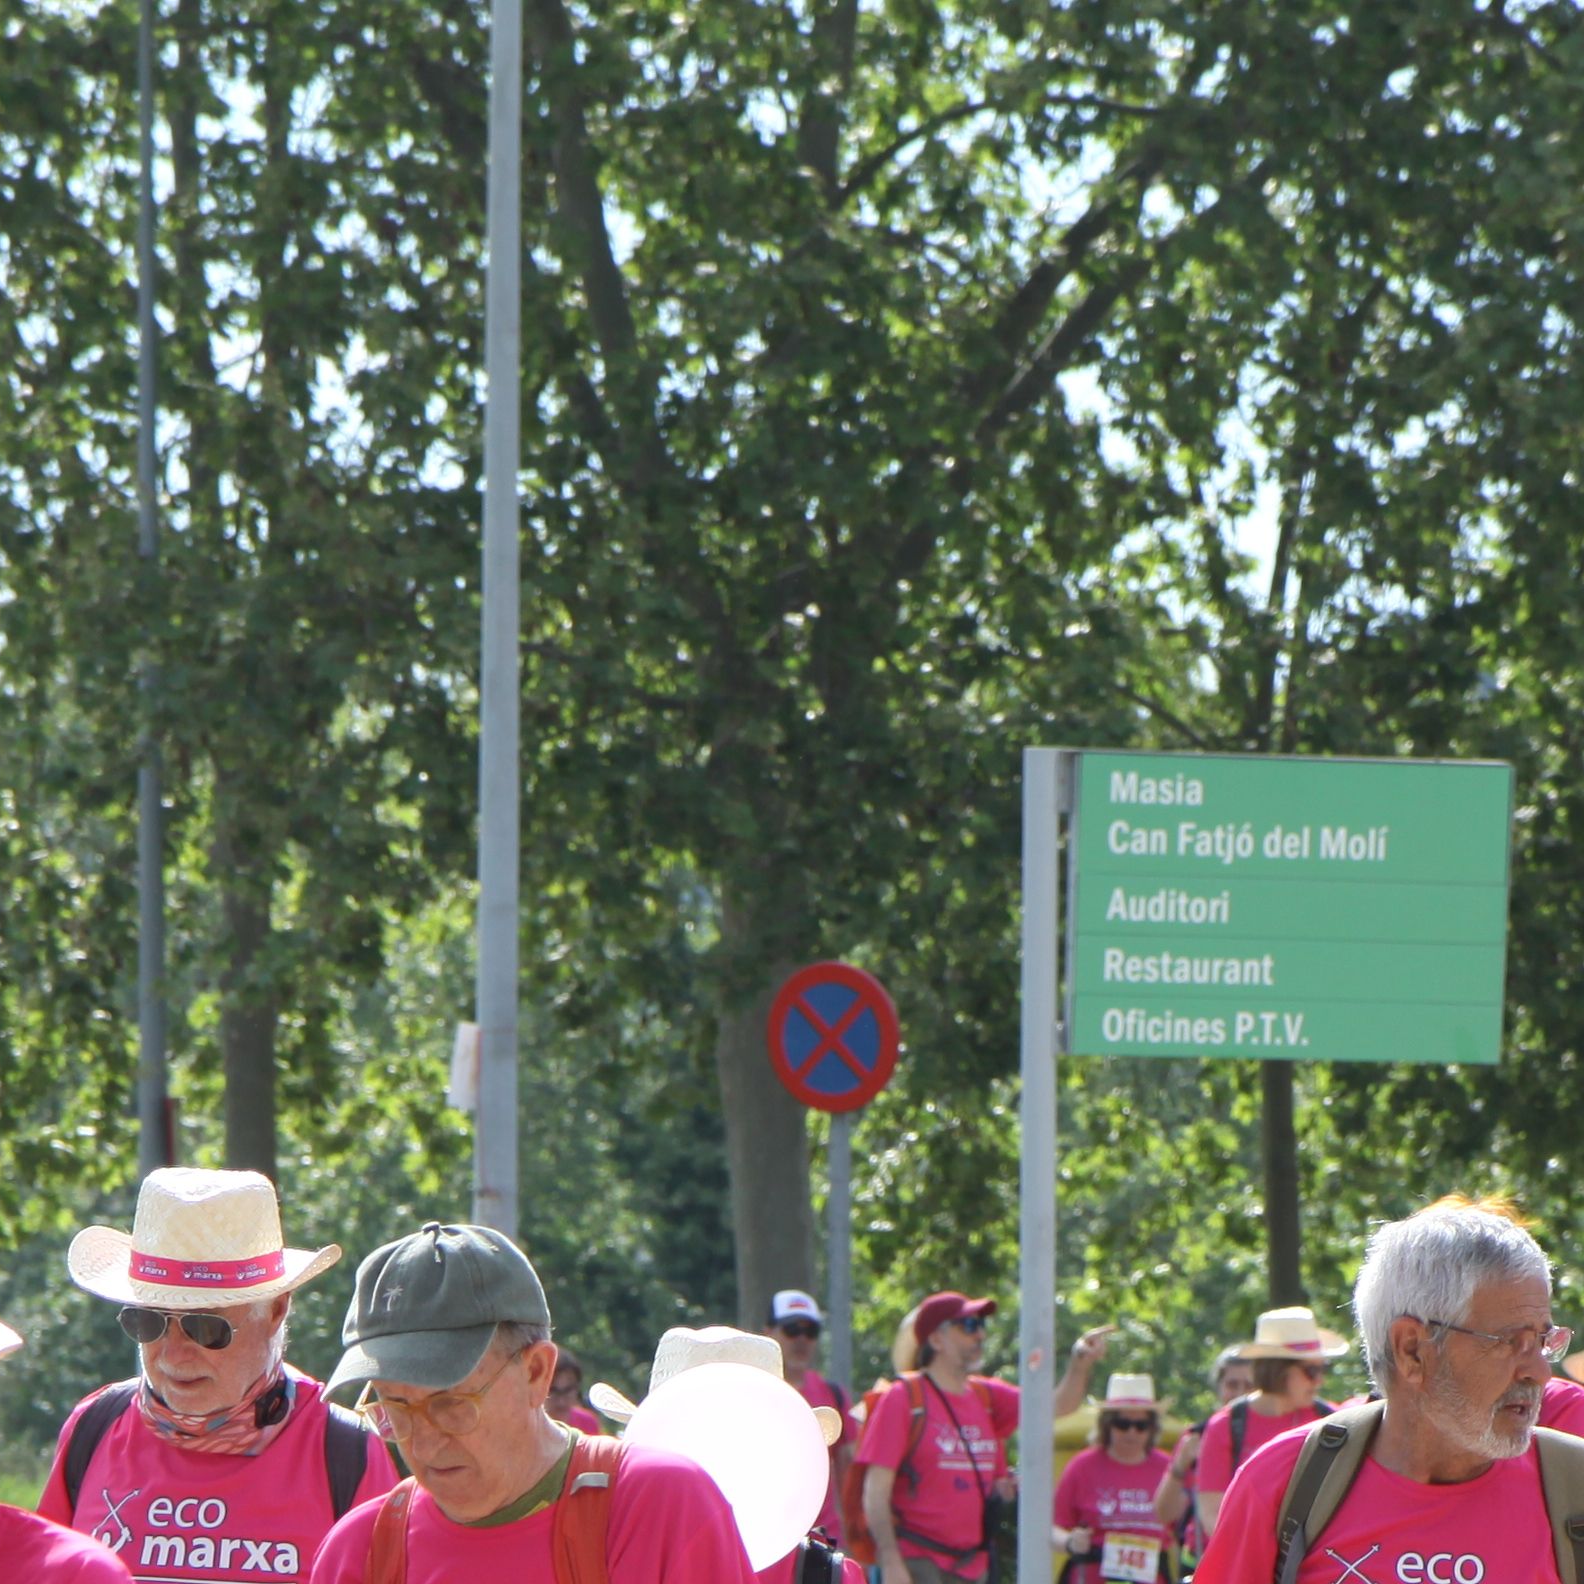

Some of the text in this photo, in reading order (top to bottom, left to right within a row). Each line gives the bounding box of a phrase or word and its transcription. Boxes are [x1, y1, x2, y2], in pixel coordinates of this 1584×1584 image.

[1110, 772, 1203, 806] Masia
[1108, 821, 1389, 864] Can Fatjó del Molí
[1107, 887, 1230, 924] Auditori
[1104, 948, 1273, 986] Restaurant
[1102, 1008, 1309, 1047] Oficines P.T.V.
[147, 1497, 227, 1528] eco
[140, 1533, 299, 1575] marxa
[1396, 1552, 1484, 1584] eco
